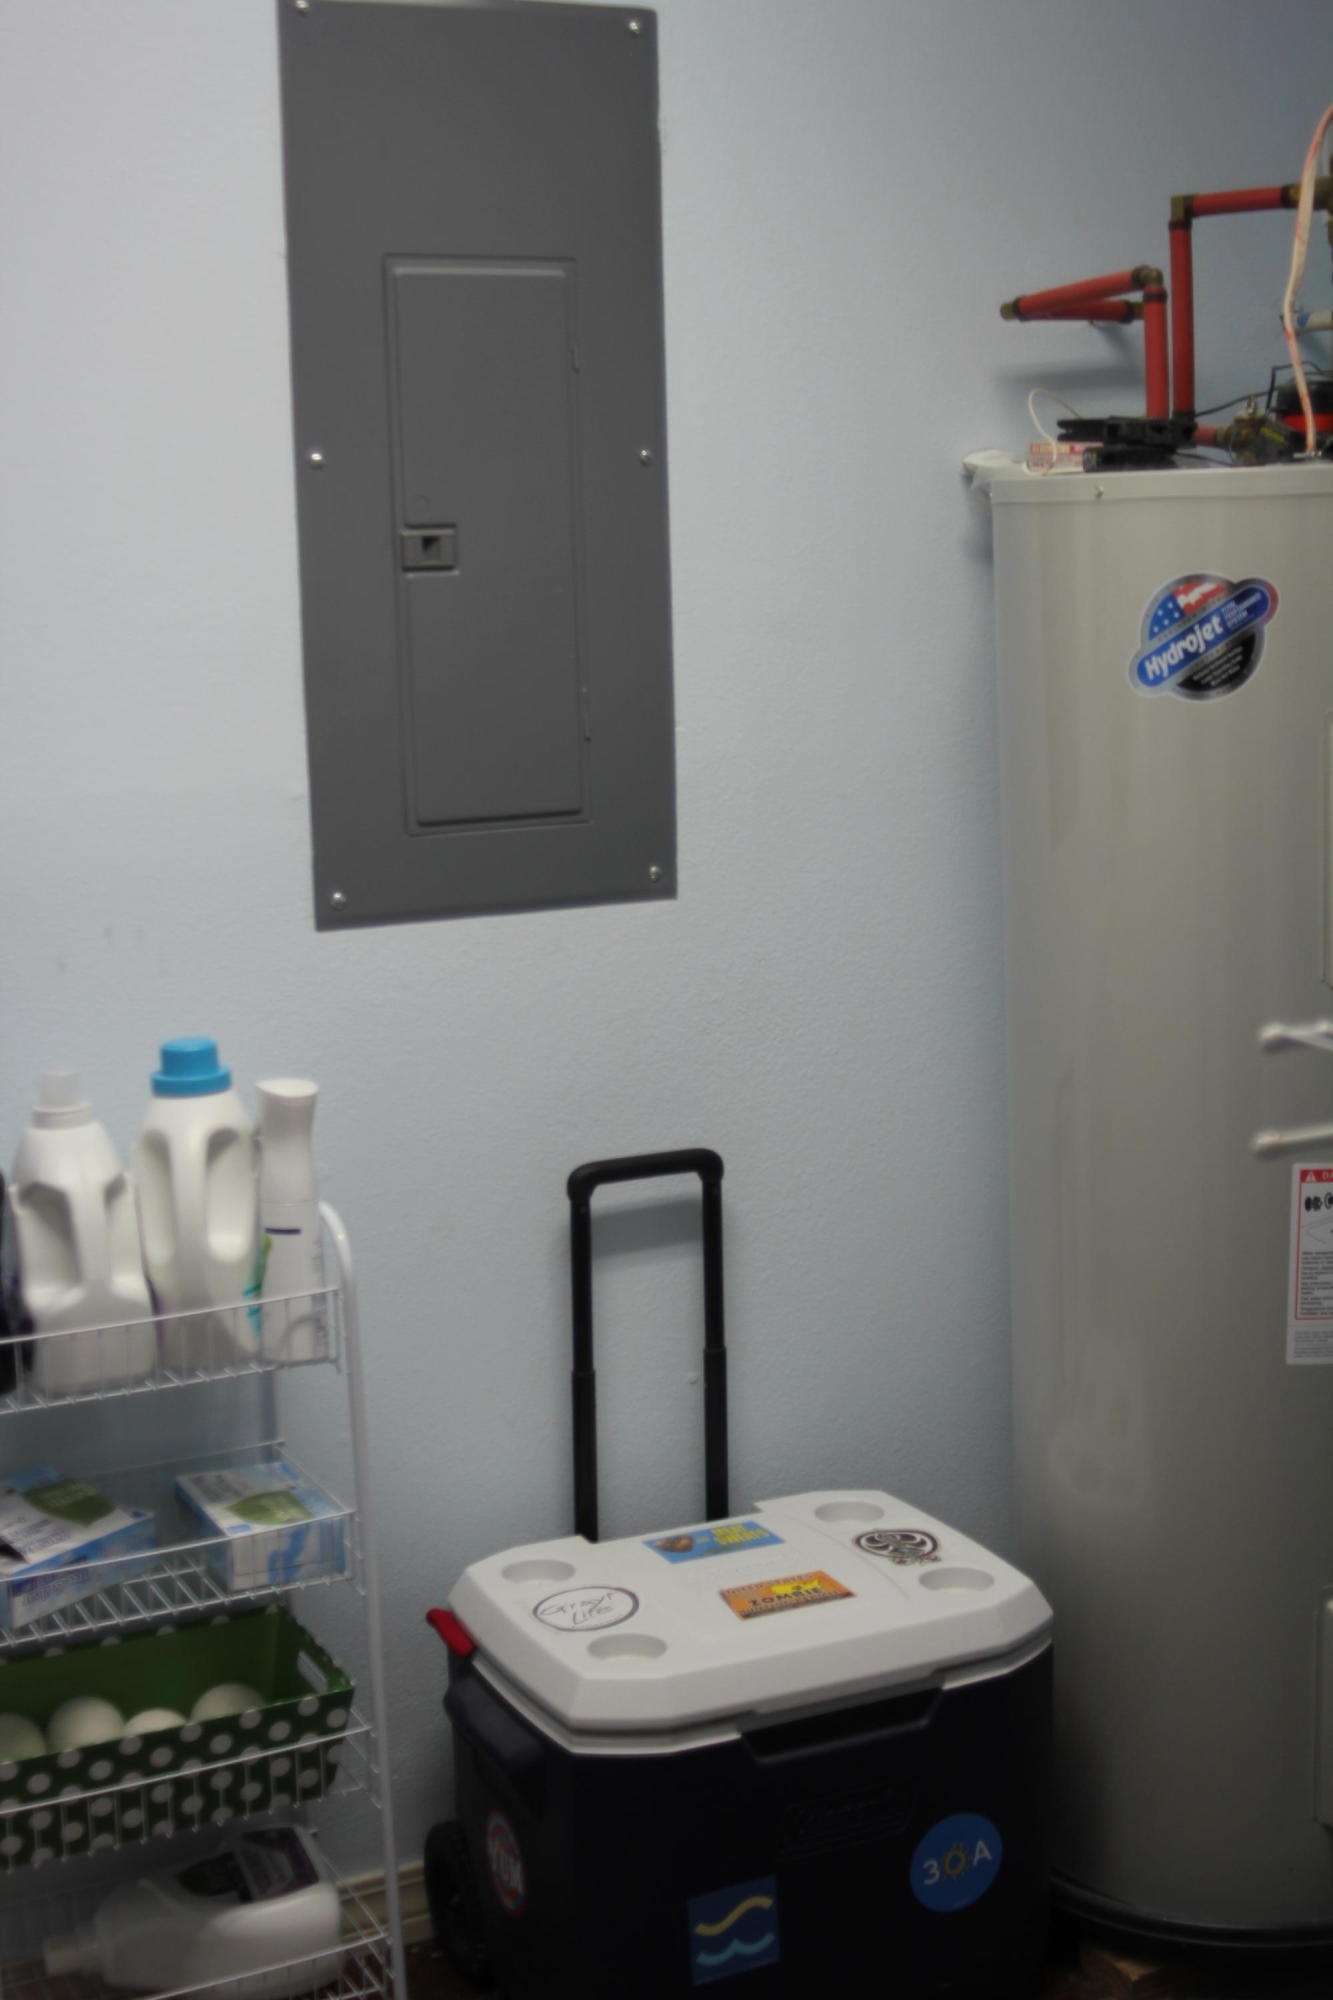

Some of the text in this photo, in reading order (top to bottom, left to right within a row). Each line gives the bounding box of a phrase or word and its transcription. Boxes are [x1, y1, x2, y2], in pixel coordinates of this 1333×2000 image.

[1144, 615, 1224, 680] Hydrojet
[749, 1586, 823, 1607] ZOMBIE
[922, 1838, 992, 1886] 30A
